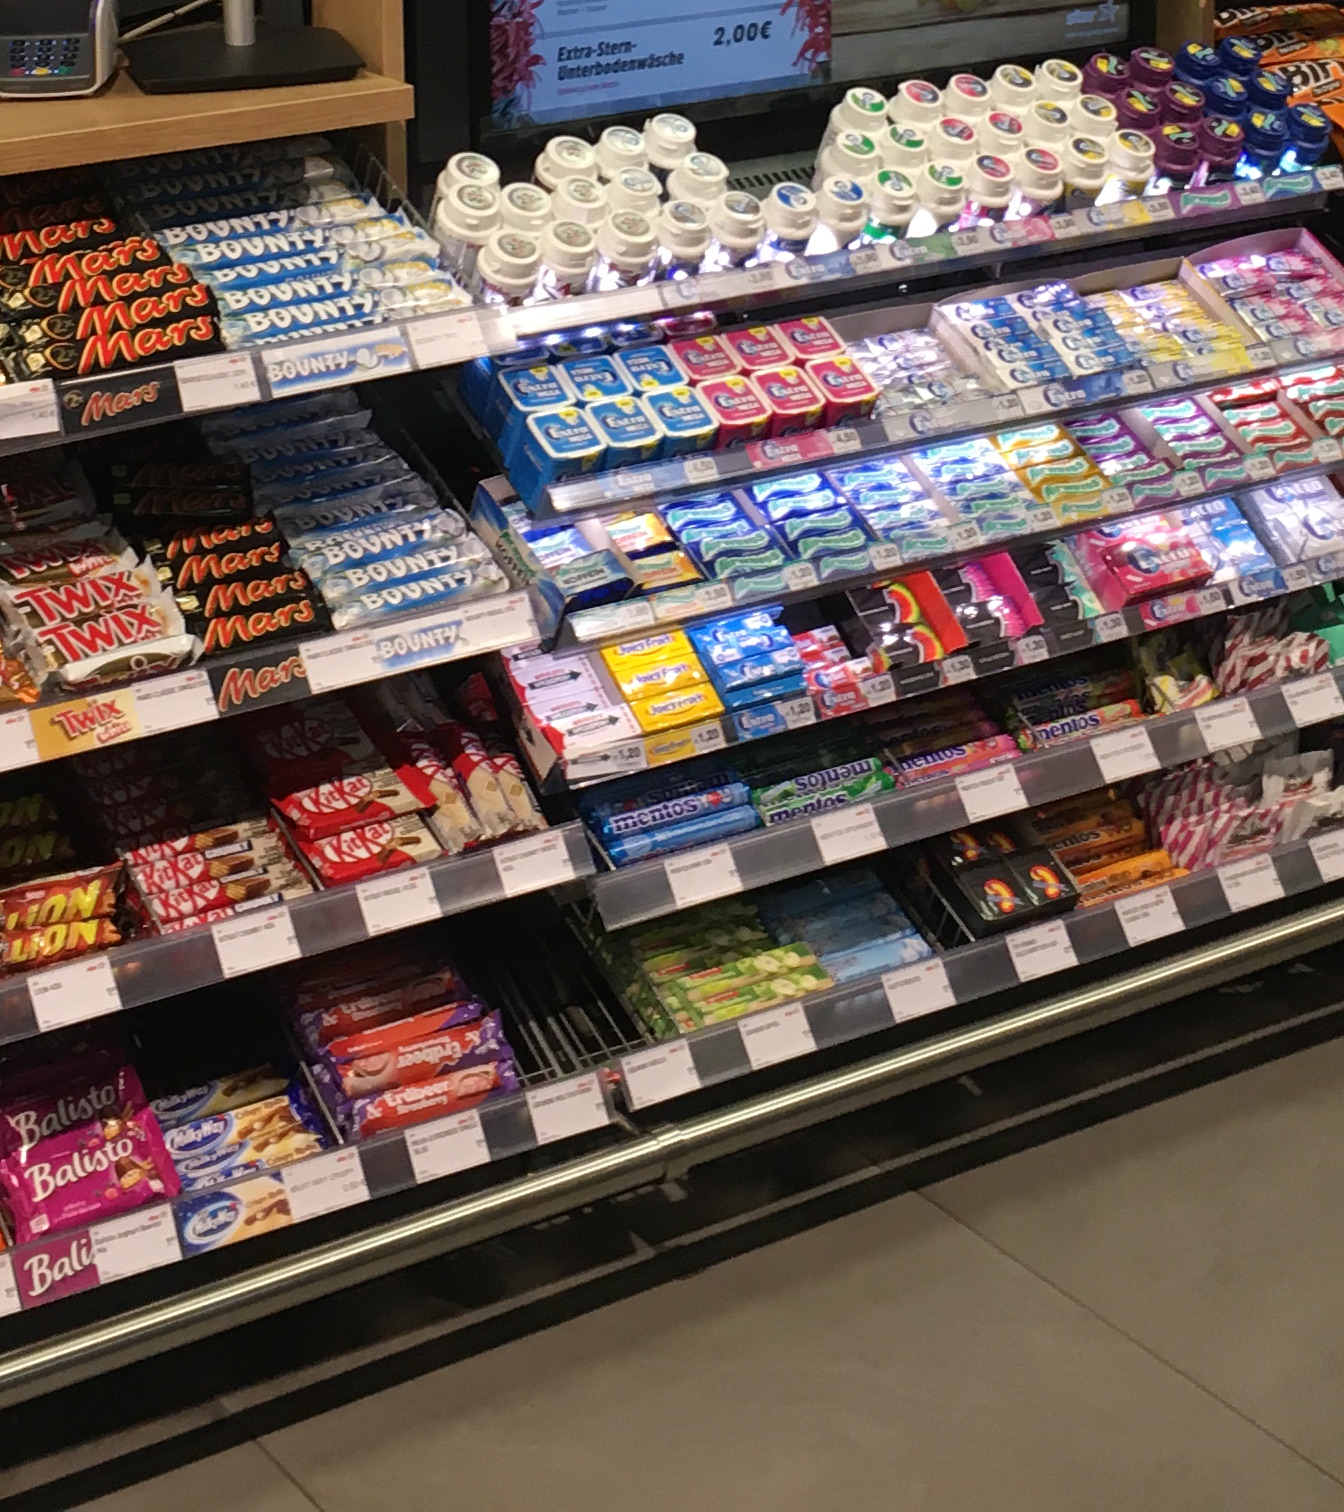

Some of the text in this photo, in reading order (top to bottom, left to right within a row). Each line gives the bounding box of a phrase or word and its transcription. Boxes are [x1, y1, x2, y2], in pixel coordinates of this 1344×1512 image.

[557, 20, 773, 62] Extra-Stern- 2,00€
[557, 51, 685, 81] Unterbodenwäsche
[165, 214, 289, 245] BOUNTY
[198, 230, 323, 264] BOUNTY
[59, 261, 190, 315] Mars
[226, 266, 352, 309] BOUNTY
[77, 285, 207, 340] Mars
[250, 295, 375, 335] BOUNTY
[79, 315, 215, 375] Mars
[268, 351, 349, 381] BOUNTY
[82, 380, 160, 425] Mars
[176, 539, 285, 590] Mars
[324, 520, 435, 567] BOUNTY
[345, 546, 461, 590] BOUNTY
[204, 567, 310, 618] Mars
[360, 568, 473, 613] BOUNTY
[203, 596, 317, 654] Mars
[377, 625, 461, 660] BOUNTY
[219, 657, 308, 712] Mars
[301, 775, 370, 813] KitKat
[794, 757, 873, 791] mentos
[613, 797, 698, 833] mentos
[323, 822, 391, 862] KitKat
[152, 878, 220, 919] KitKat
[384, 1080, 450, 1108] Erdbeer
[15, 1084, 118, 1150] Balisto
[23, 1136, 135, 1204] Balisto
